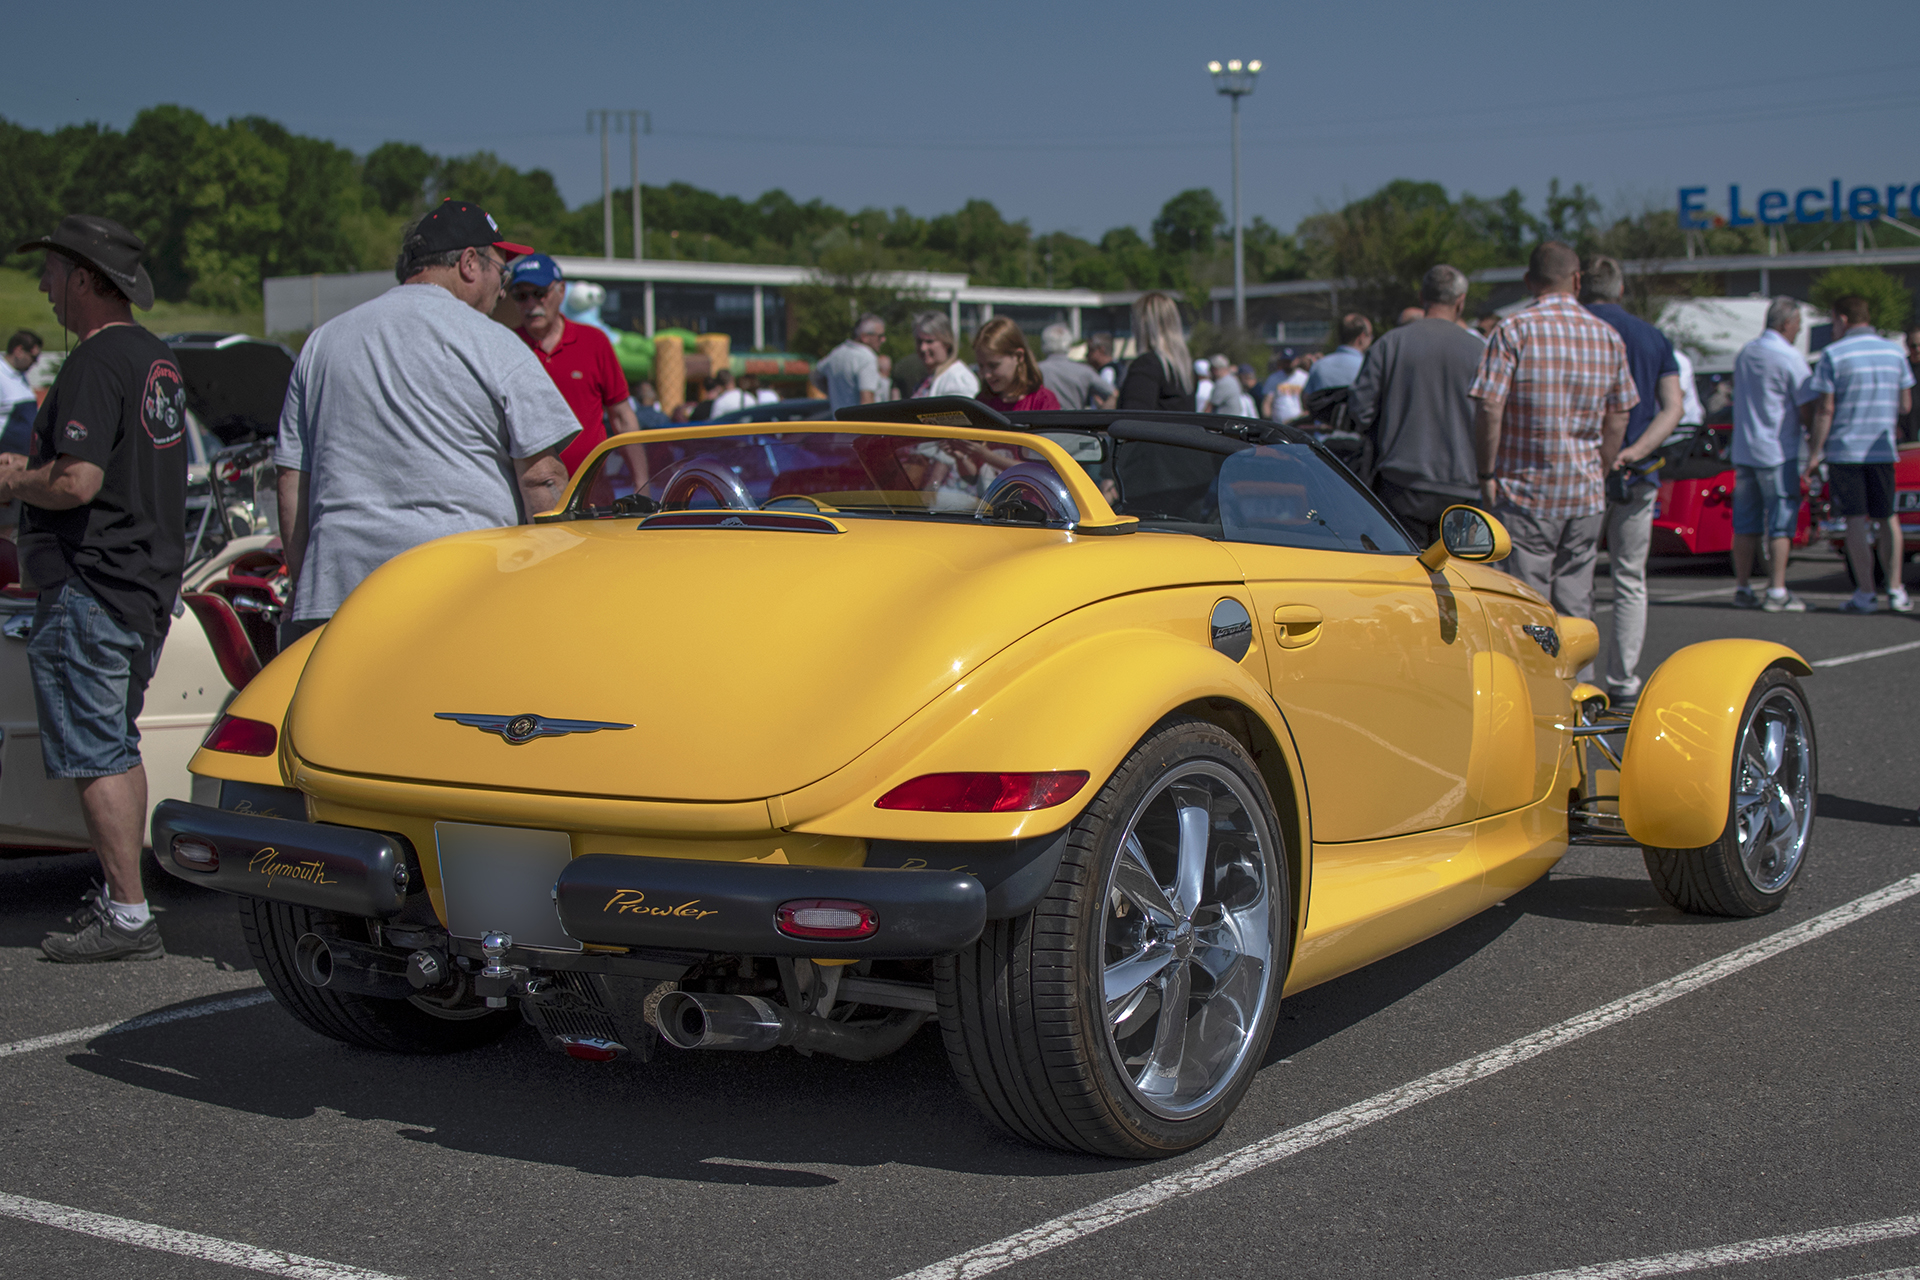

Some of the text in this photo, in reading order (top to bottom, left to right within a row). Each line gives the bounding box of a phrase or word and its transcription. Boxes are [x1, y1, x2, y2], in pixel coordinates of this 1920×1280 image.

[1197, 733, 1242, 759] TOYO
[248, 846, 338, 889] Plymouth
[602, 888, 719, 921] Prowler
